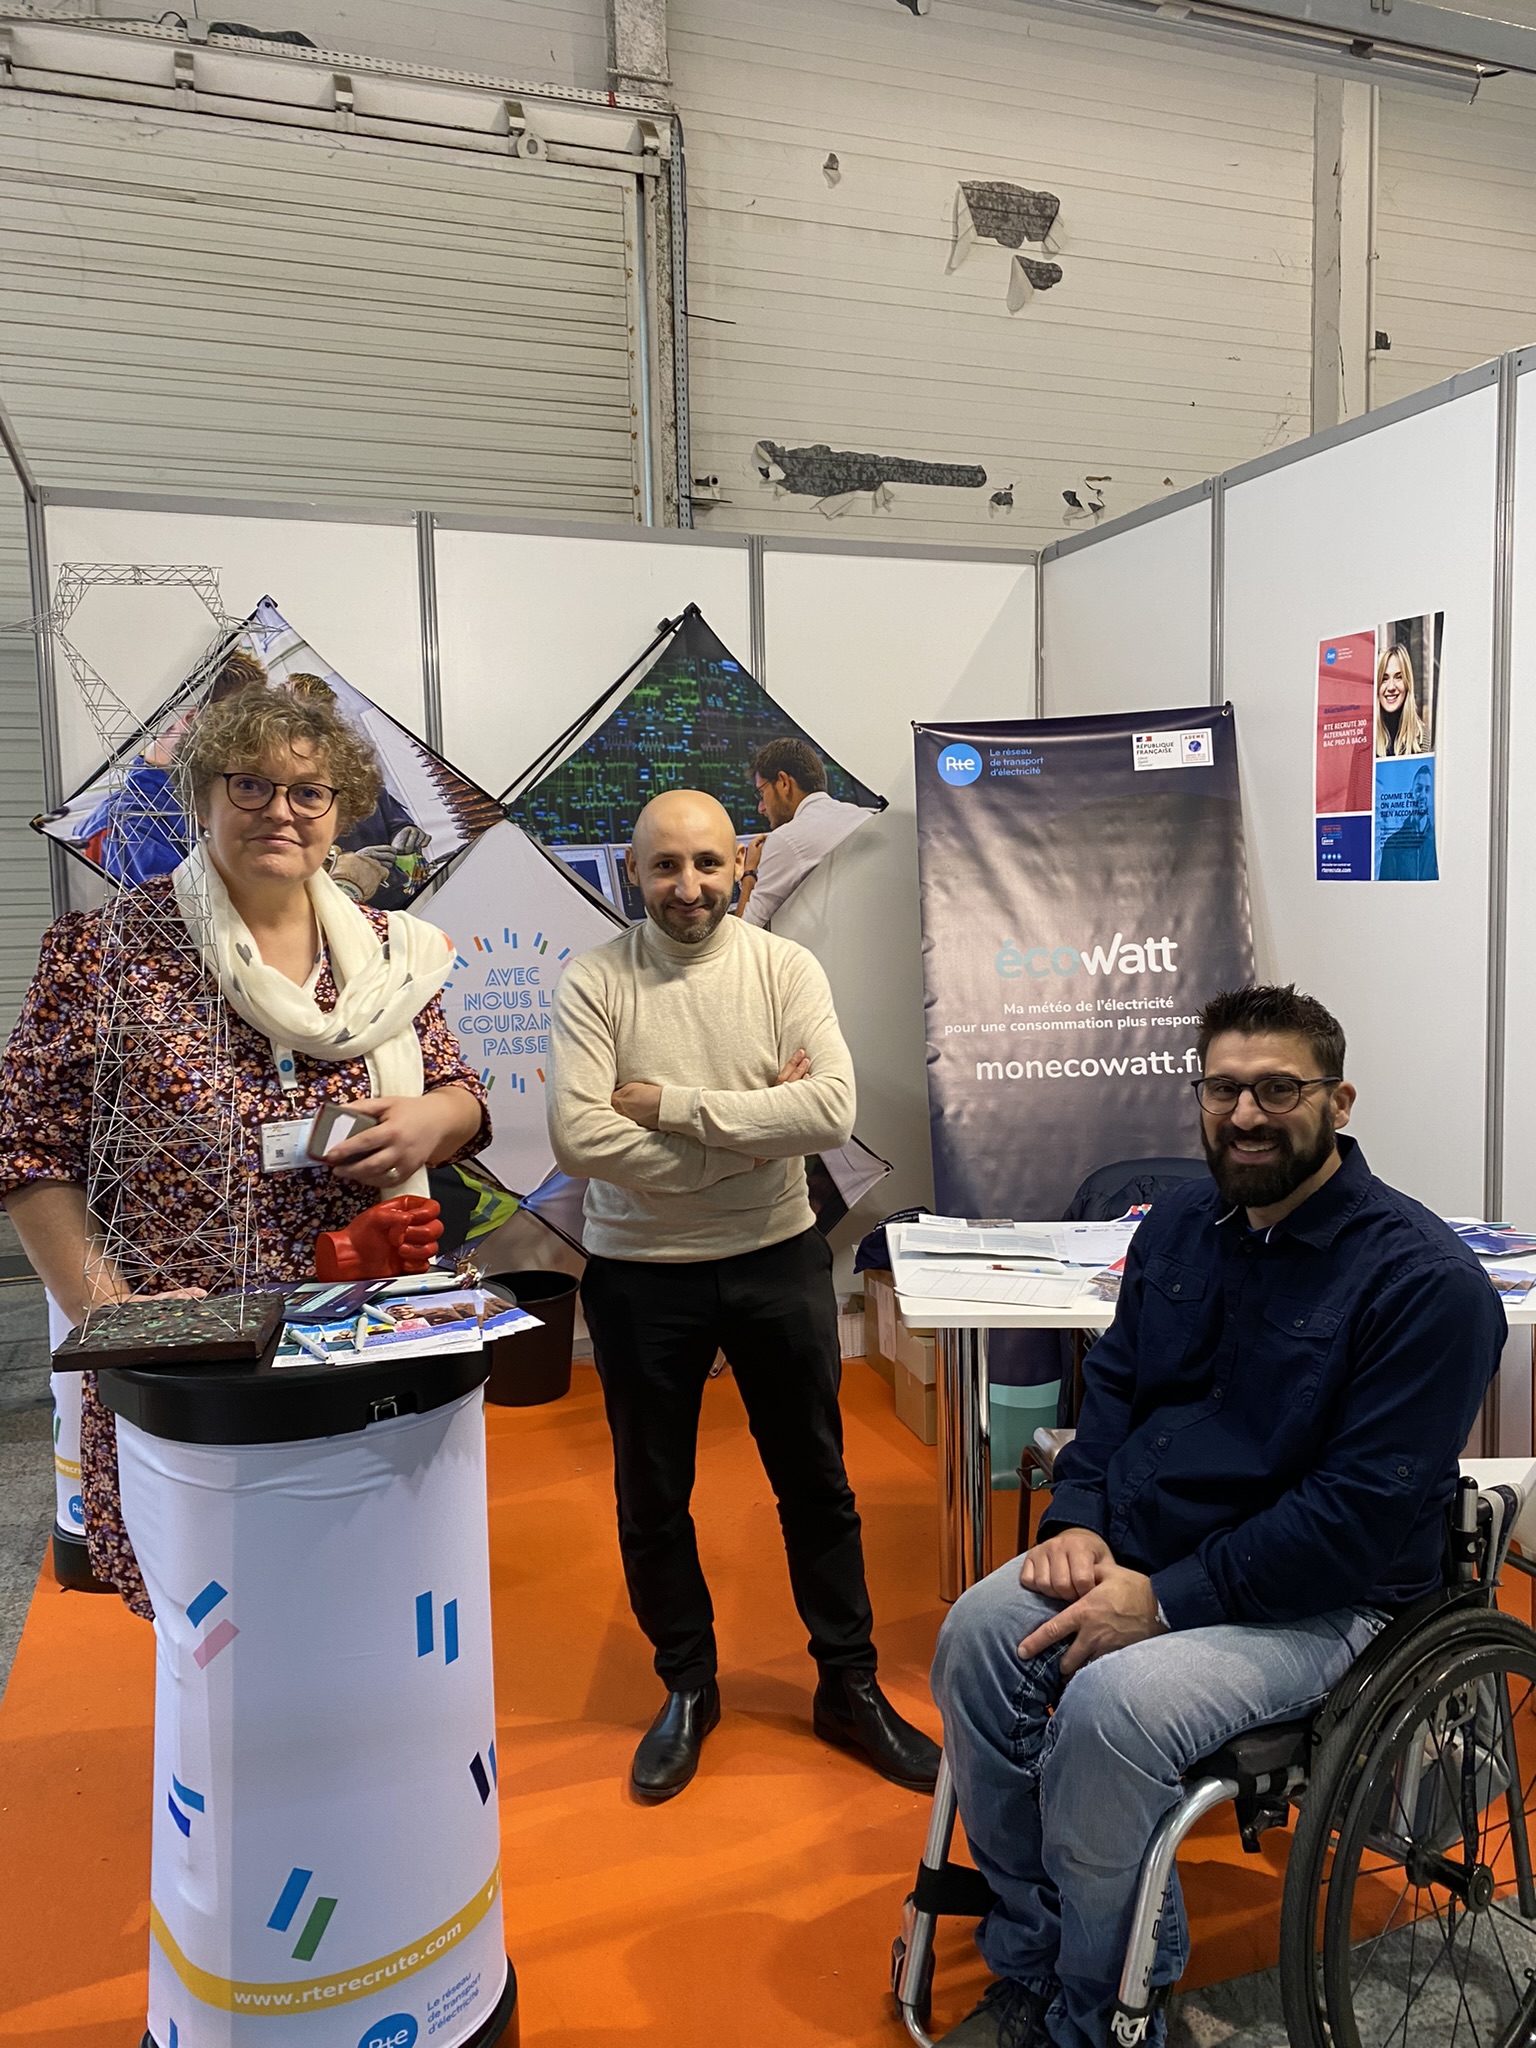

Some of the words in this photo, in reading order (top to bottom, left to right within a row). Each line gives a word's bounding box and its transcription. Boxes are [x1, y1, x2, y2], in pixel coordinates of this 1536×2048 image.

[1334, 720, 1357, 730] RECRUTE
[1323, 728, 1356, 739] ALTERNANTS
[1356, 727, 1364, 735] DE
[1136, 741, 1174, 749] RÉPUBLIQUE
[1323, 740, 1334, 748] BAC
[1334, 738, 1345, 746] PRO
[989, 748, 1001, 756] Le
[1002, 747, 1032, 756] réseau
[1136, 747, 1172, 755] FRANÇAISE
[945, 756, 975, 772] Rte
[989, 758, 1001, 767] de
[1003, 756, 1044, 767] transport
[990, 766, 1041, 777] d'électricité
[1380, 792, 1402, 801] COMME
[1390, 801, 1405, 809] AIME
[1405, 800, 1419, 808] ÊTRE
[1380, 810, 1393, 818] BIEN
[484, 966, 540, 987] AVEC
[464, 990, 532, 1011] NOUS
[538, 989, 555, 1008] L
[1003, 1003, 1024, 1015] Ma
[1028, 999, 1072, 1014] météo
[1075, 1000, 1093, 1012] de
[1096, 996, 1174, 1012] l'électricité
[944, 1022, 976, 1035] pour
[981, 1021, 1006, 1032] une
[1009, 1016, 1113, 1032] consommation
[1117, 1015, 1147, 1031] plus
[1151, 1014, 1204, 1028] respon
[483, 1035, 549, 1057] PASSE
[233, 1922, 462, 2007] www.rterecrute.com
[427, 1998, 440, 2012] Le
[441, 1972, 472, 2001] réseau
[427, 2010, 441, 2023] de
[442, 1973, 481, 2011] transport
[427, 1988, 480, 2035] d'électricité
